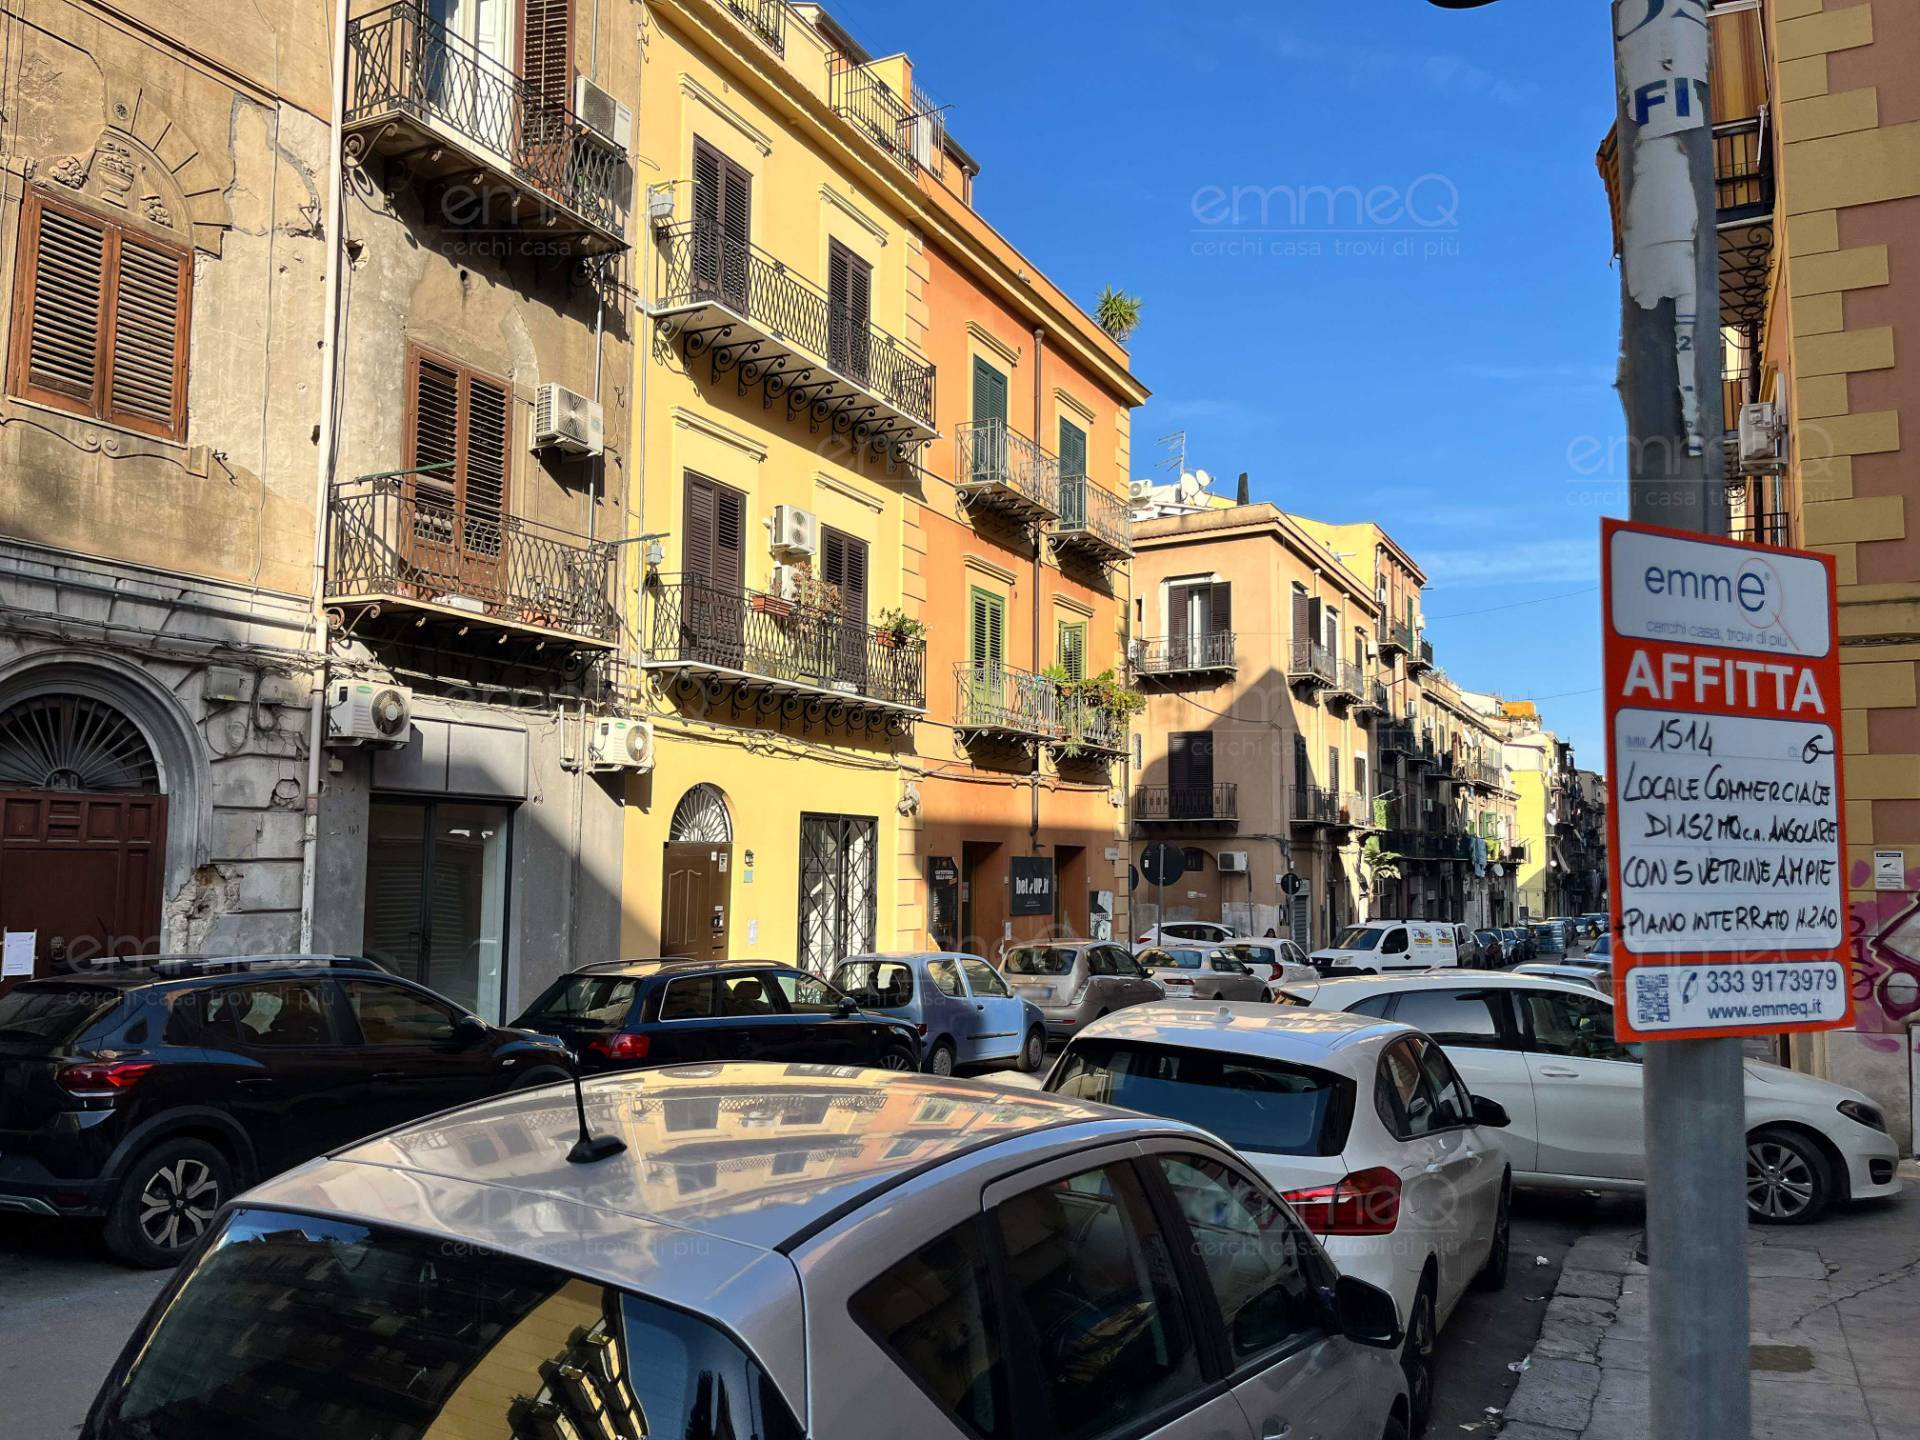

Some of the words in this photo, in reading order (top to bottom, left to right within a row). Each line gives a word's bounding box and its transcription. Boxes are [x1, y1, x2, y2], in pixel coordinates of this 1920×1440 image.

[1622, 649, 1825, 714] AFFITTA
[1650, 718, 1713, 757] 1514
[1623, 760, 1699, 802] LOCALE
[1704, 763, 1831, 806] COMMERCIALE
[1644, 812, 1672, 838] DI
[1676, 812, 1714, 842] 152
[1769, 815, 1838, 843] ANGOLARE
[1623, 855, 1668, 888] CON
[1674, 860, 1693, 885] 5
[1698, 856, 1771, 885] VETRINE
[1693, 905, 1789, 932] INTERRATO
[1706, 970, 1745, 994] 333
[1752, 968, 1837, 993] 9173979
[1707, 998, 1822, 1020] www.emmeq.it
